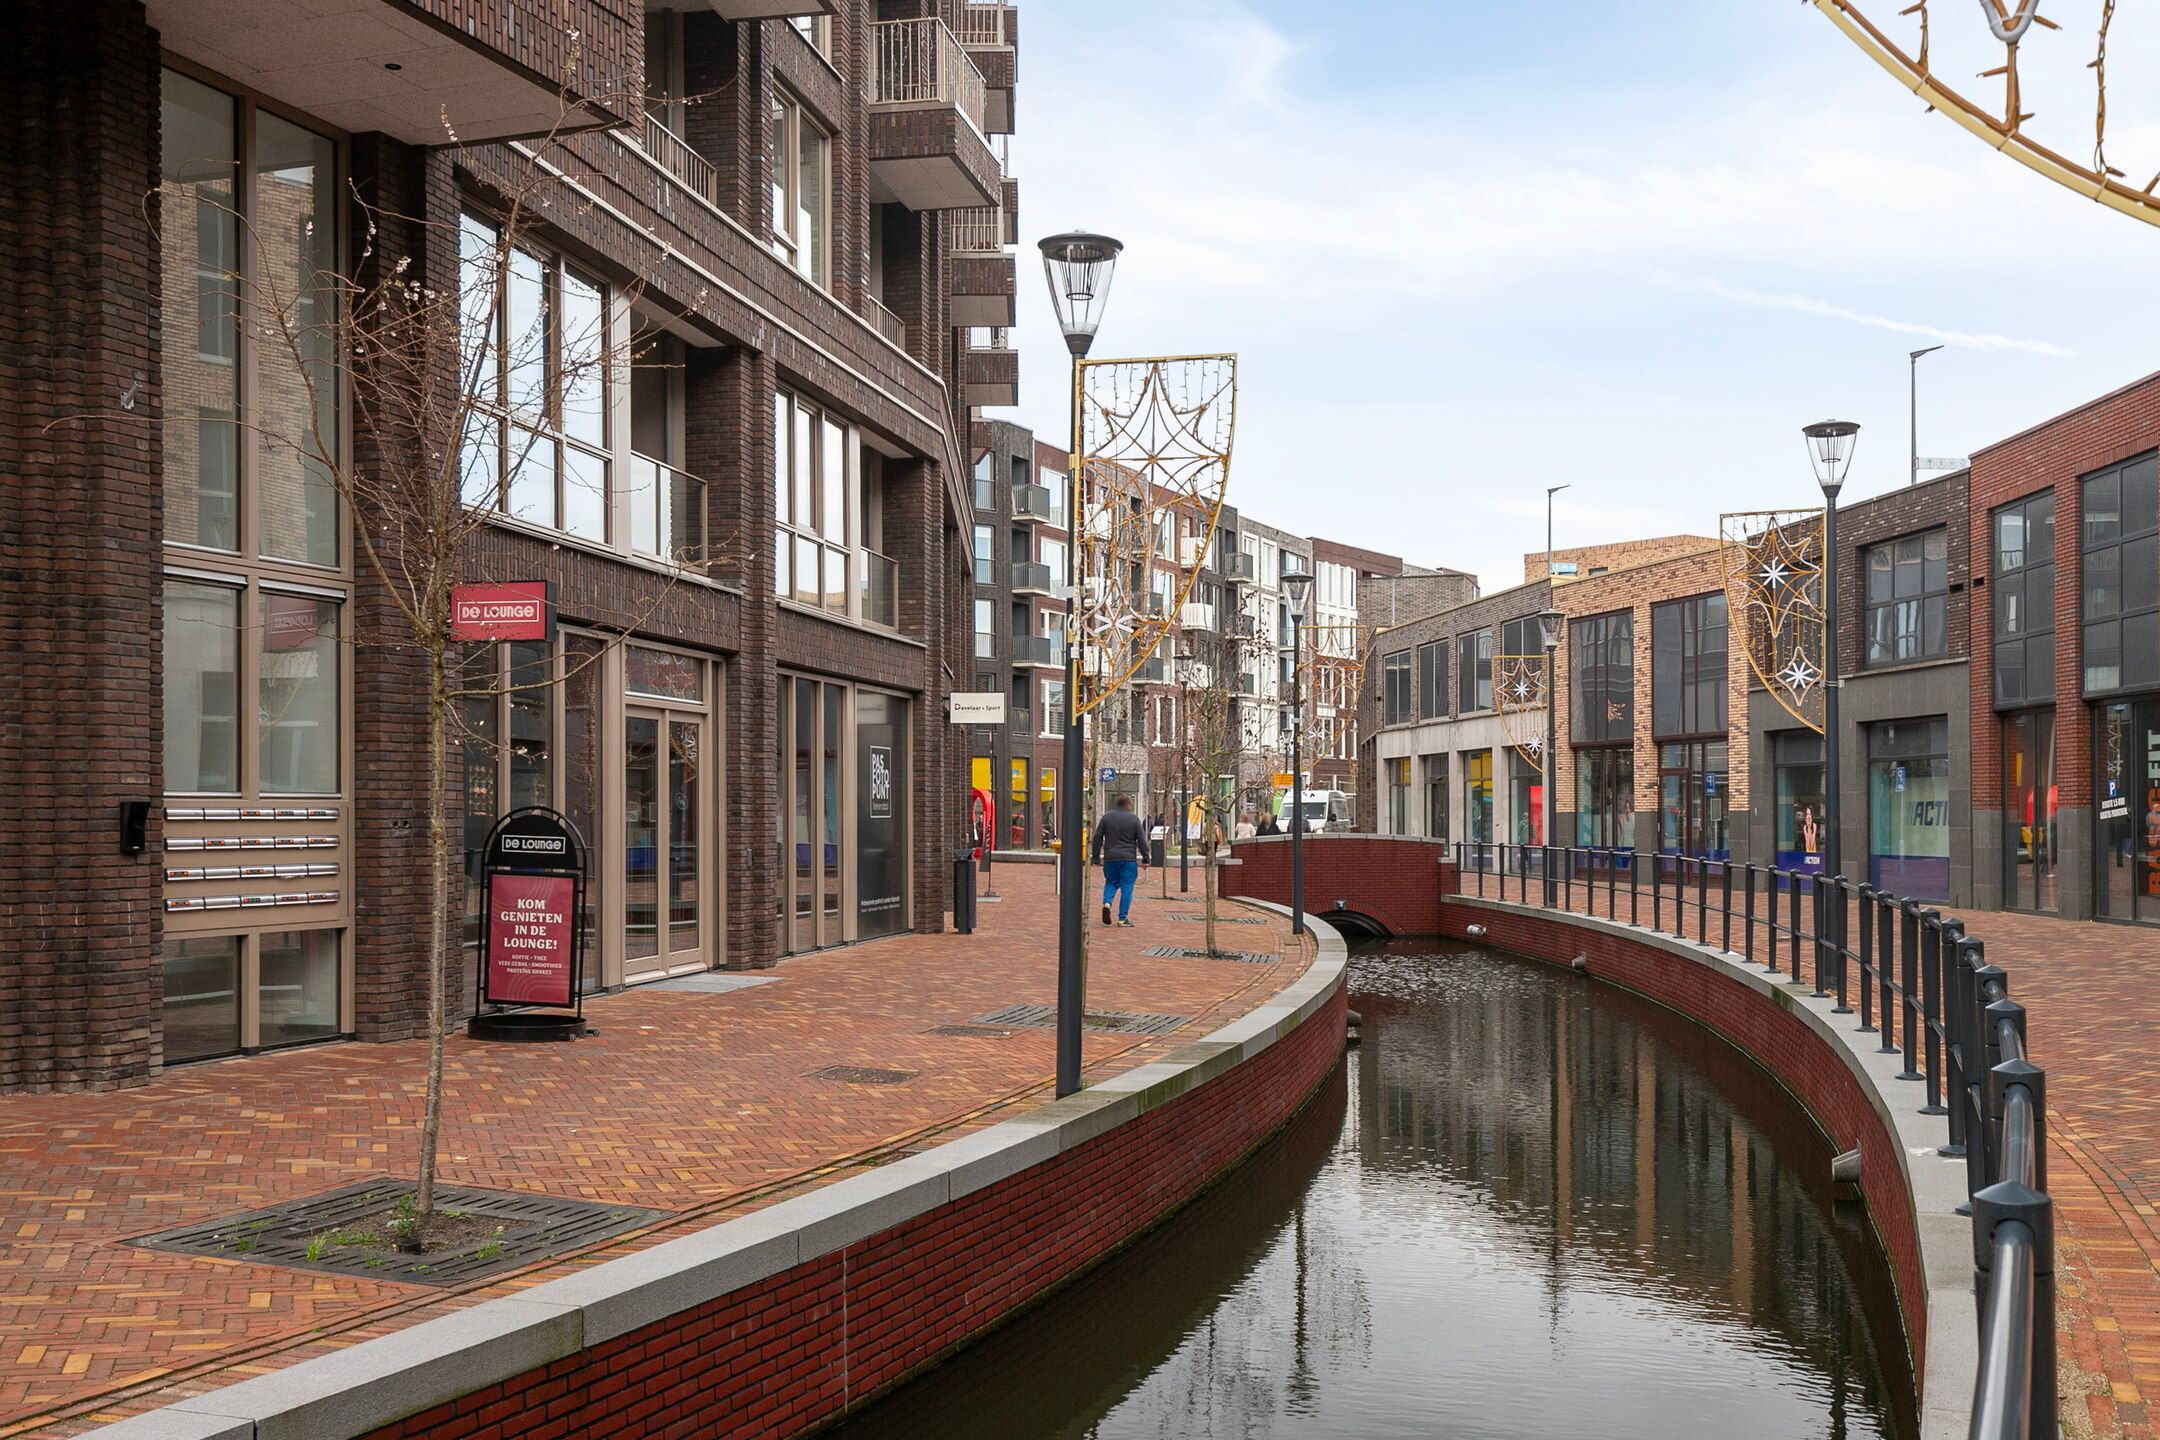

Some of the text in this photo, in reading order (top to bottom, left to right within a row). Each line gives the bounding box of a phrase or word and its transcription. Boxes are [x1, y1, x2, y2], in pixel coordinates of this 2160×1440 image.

[872, 753, 884, 769] PAS
[872, 768, 890, 784] FOTO
[872, 783, 890, 799] PUNT
[517, 899, 546, 910] KOM
[500, 911, 563, 924] GENIETEN
[514, 925, 547, 936] IN DE
[503, 937, 558, 950] LOUNGE!
